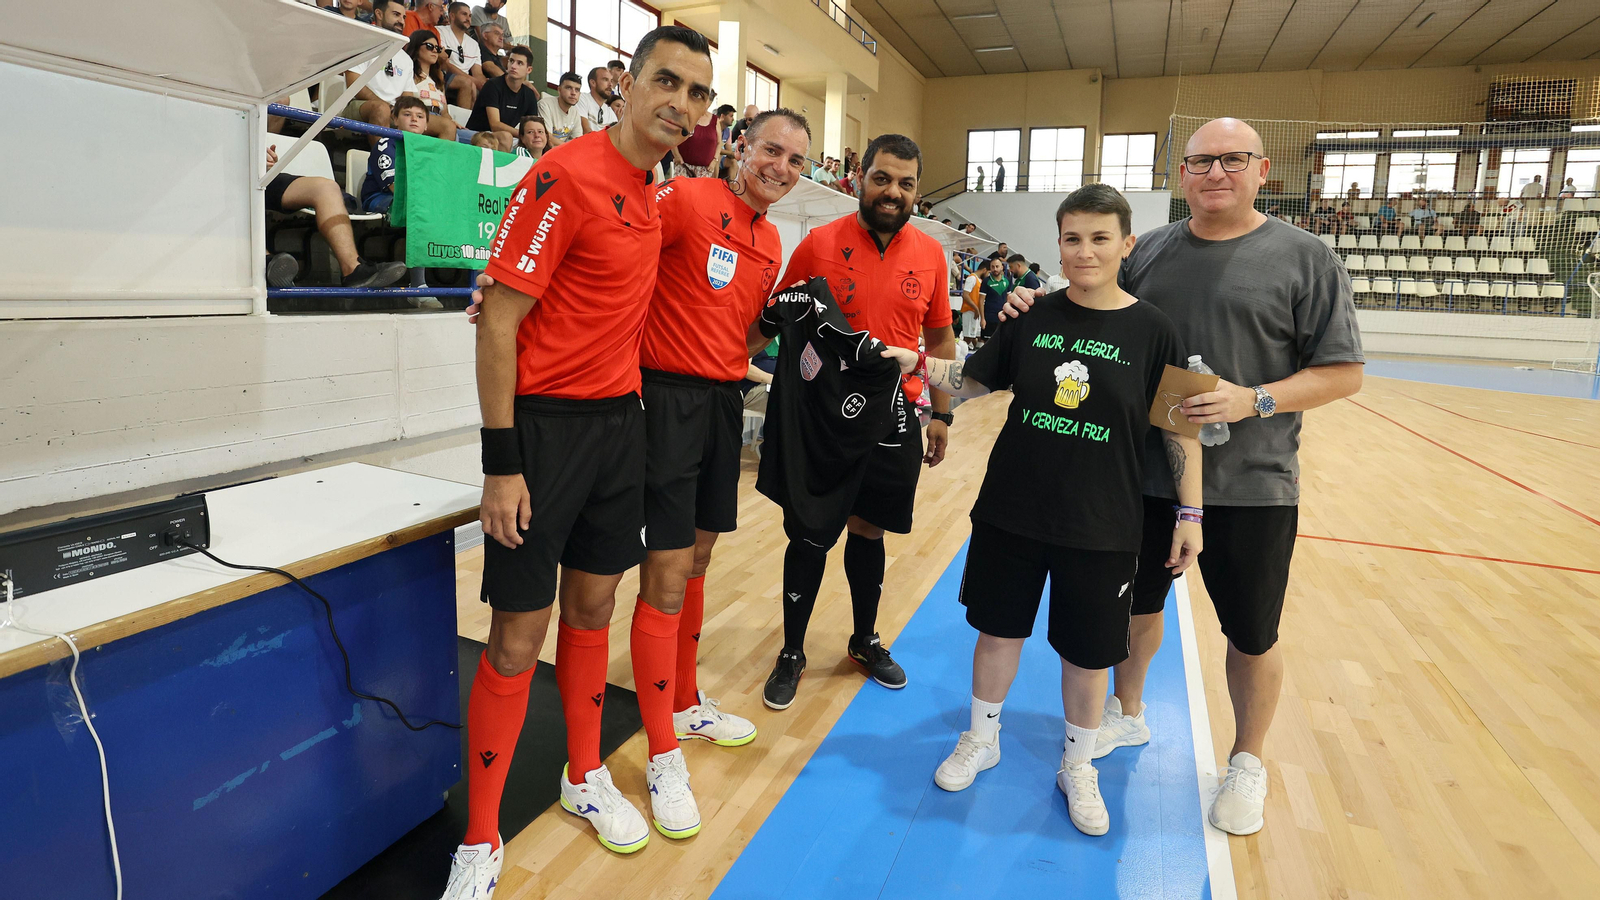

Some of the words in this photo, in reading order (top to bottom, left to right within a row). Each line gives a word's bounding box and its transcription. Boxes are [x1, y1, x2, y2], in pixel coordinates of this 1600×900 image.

[655, 186, 674, 203] RTH
[477, 193, 502, 216] Real
[477, 221, 500, 240] 19
[492, 205, 520, 259] WÜRTH
[527, 201, 562, 255] WÜRTH
[427, 242, 461, 259] tuyos
[475, 246, 493, 261] año
[712, 247, 734, 264] FIFA
[711, 267, 730, 277] REFEREE
[713, 262, 729, 272] FUTSAL
[778, 291, 812, 303] WÜRH
[1032, 333, 1065, 353] AMOR,
[1070, 338, 1131, 366] ALEGRIA...
[1022, 408, 1031, 424] Y
[1031, 411, 1080, 436] CERVEZA
[1081, 422, 1111, 443] FRIA
[169, 517, 186, 525] POWER
